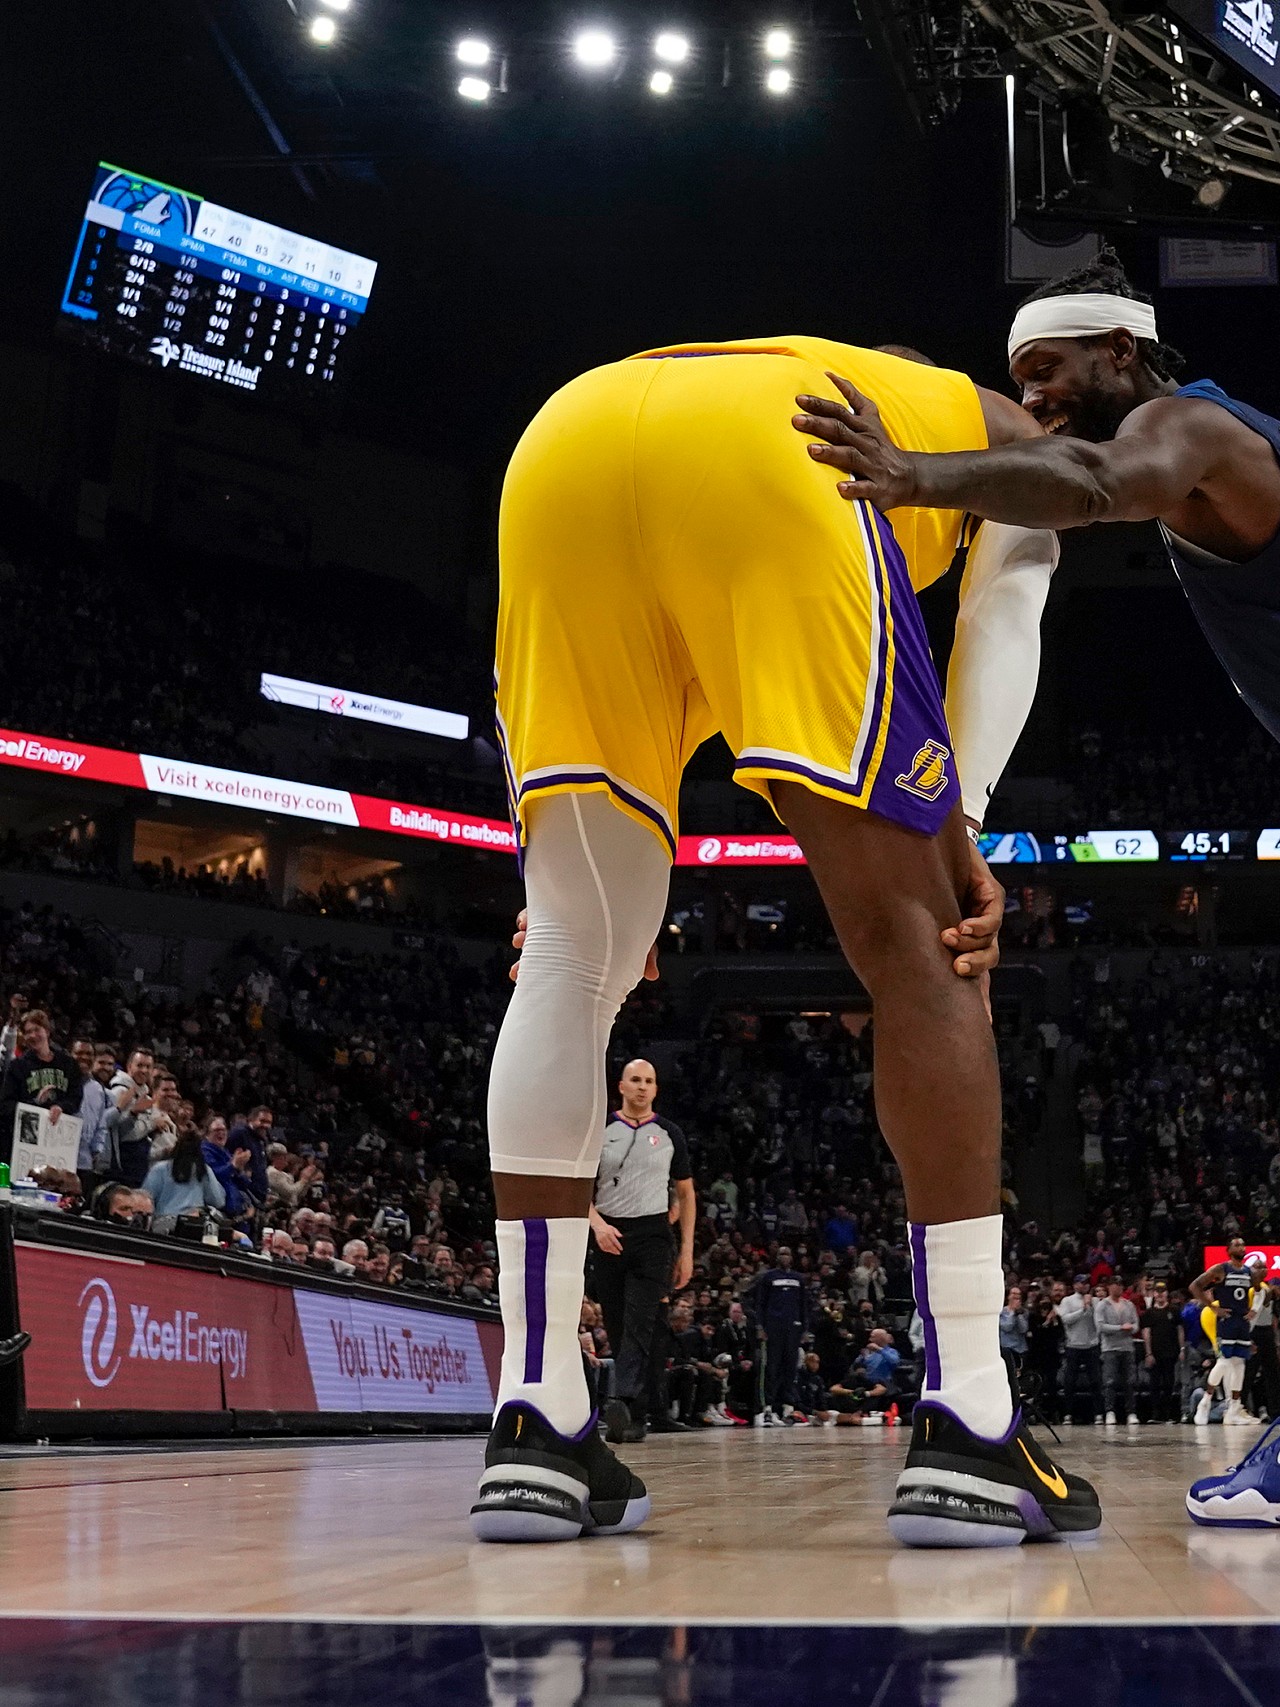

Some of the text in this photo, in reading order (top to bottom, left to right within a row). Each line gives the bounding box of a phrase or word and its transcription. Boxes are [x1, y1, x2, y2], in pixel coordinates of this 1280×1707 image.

[202, 227, 216, 238] 47
[228, 236, 242, 247] 40
[279, 252, 293, 264] 27
[305, 262, 316, 272] 11
[329, 270, 341, 282] 10
[125, 269, 145, 286] 2/4
[215, 300, 233, 315] 1/1
[272, 319, 282, 331] 2
[314, 333, 322, 345] 1
[129, 254, 156, 273] 6/12
[217, 284, 237, 299] 3/4
[276, 303, 285, 315] 3
[319, 318, 326, 329] 1
[221, 268, 240, 284] 0/1
[281, 289, 289, 300] 3
[321, 303, 330, 314] 0
[123, 286, 140, 302] 1/1
[209, 315, 229, 330] 0/0
[269, 334, 276, 346] 1
[309, 347, 318, 360] 2
[182, 343, 226, 373] Treasure
[226, 358, 260, 383] Island
[205, 330, 225, 346] 2/2
[264, 349, 273, 362] 0
[306, 363, 315, 375] 0
[0, 739, 26, 757] cel
[157, 765, 343, 814] Visit xcelenergy.com
[390, 807, 449, 838] Building
[450, 822, 460, 837] a
[1180, 832, 1230, 854] 45.1
[1115, 838, 1141, 856] 62
[1233, 1287, 1246, 1300] 0
[330, 1318, 472, 1394] You. Us. Together.
